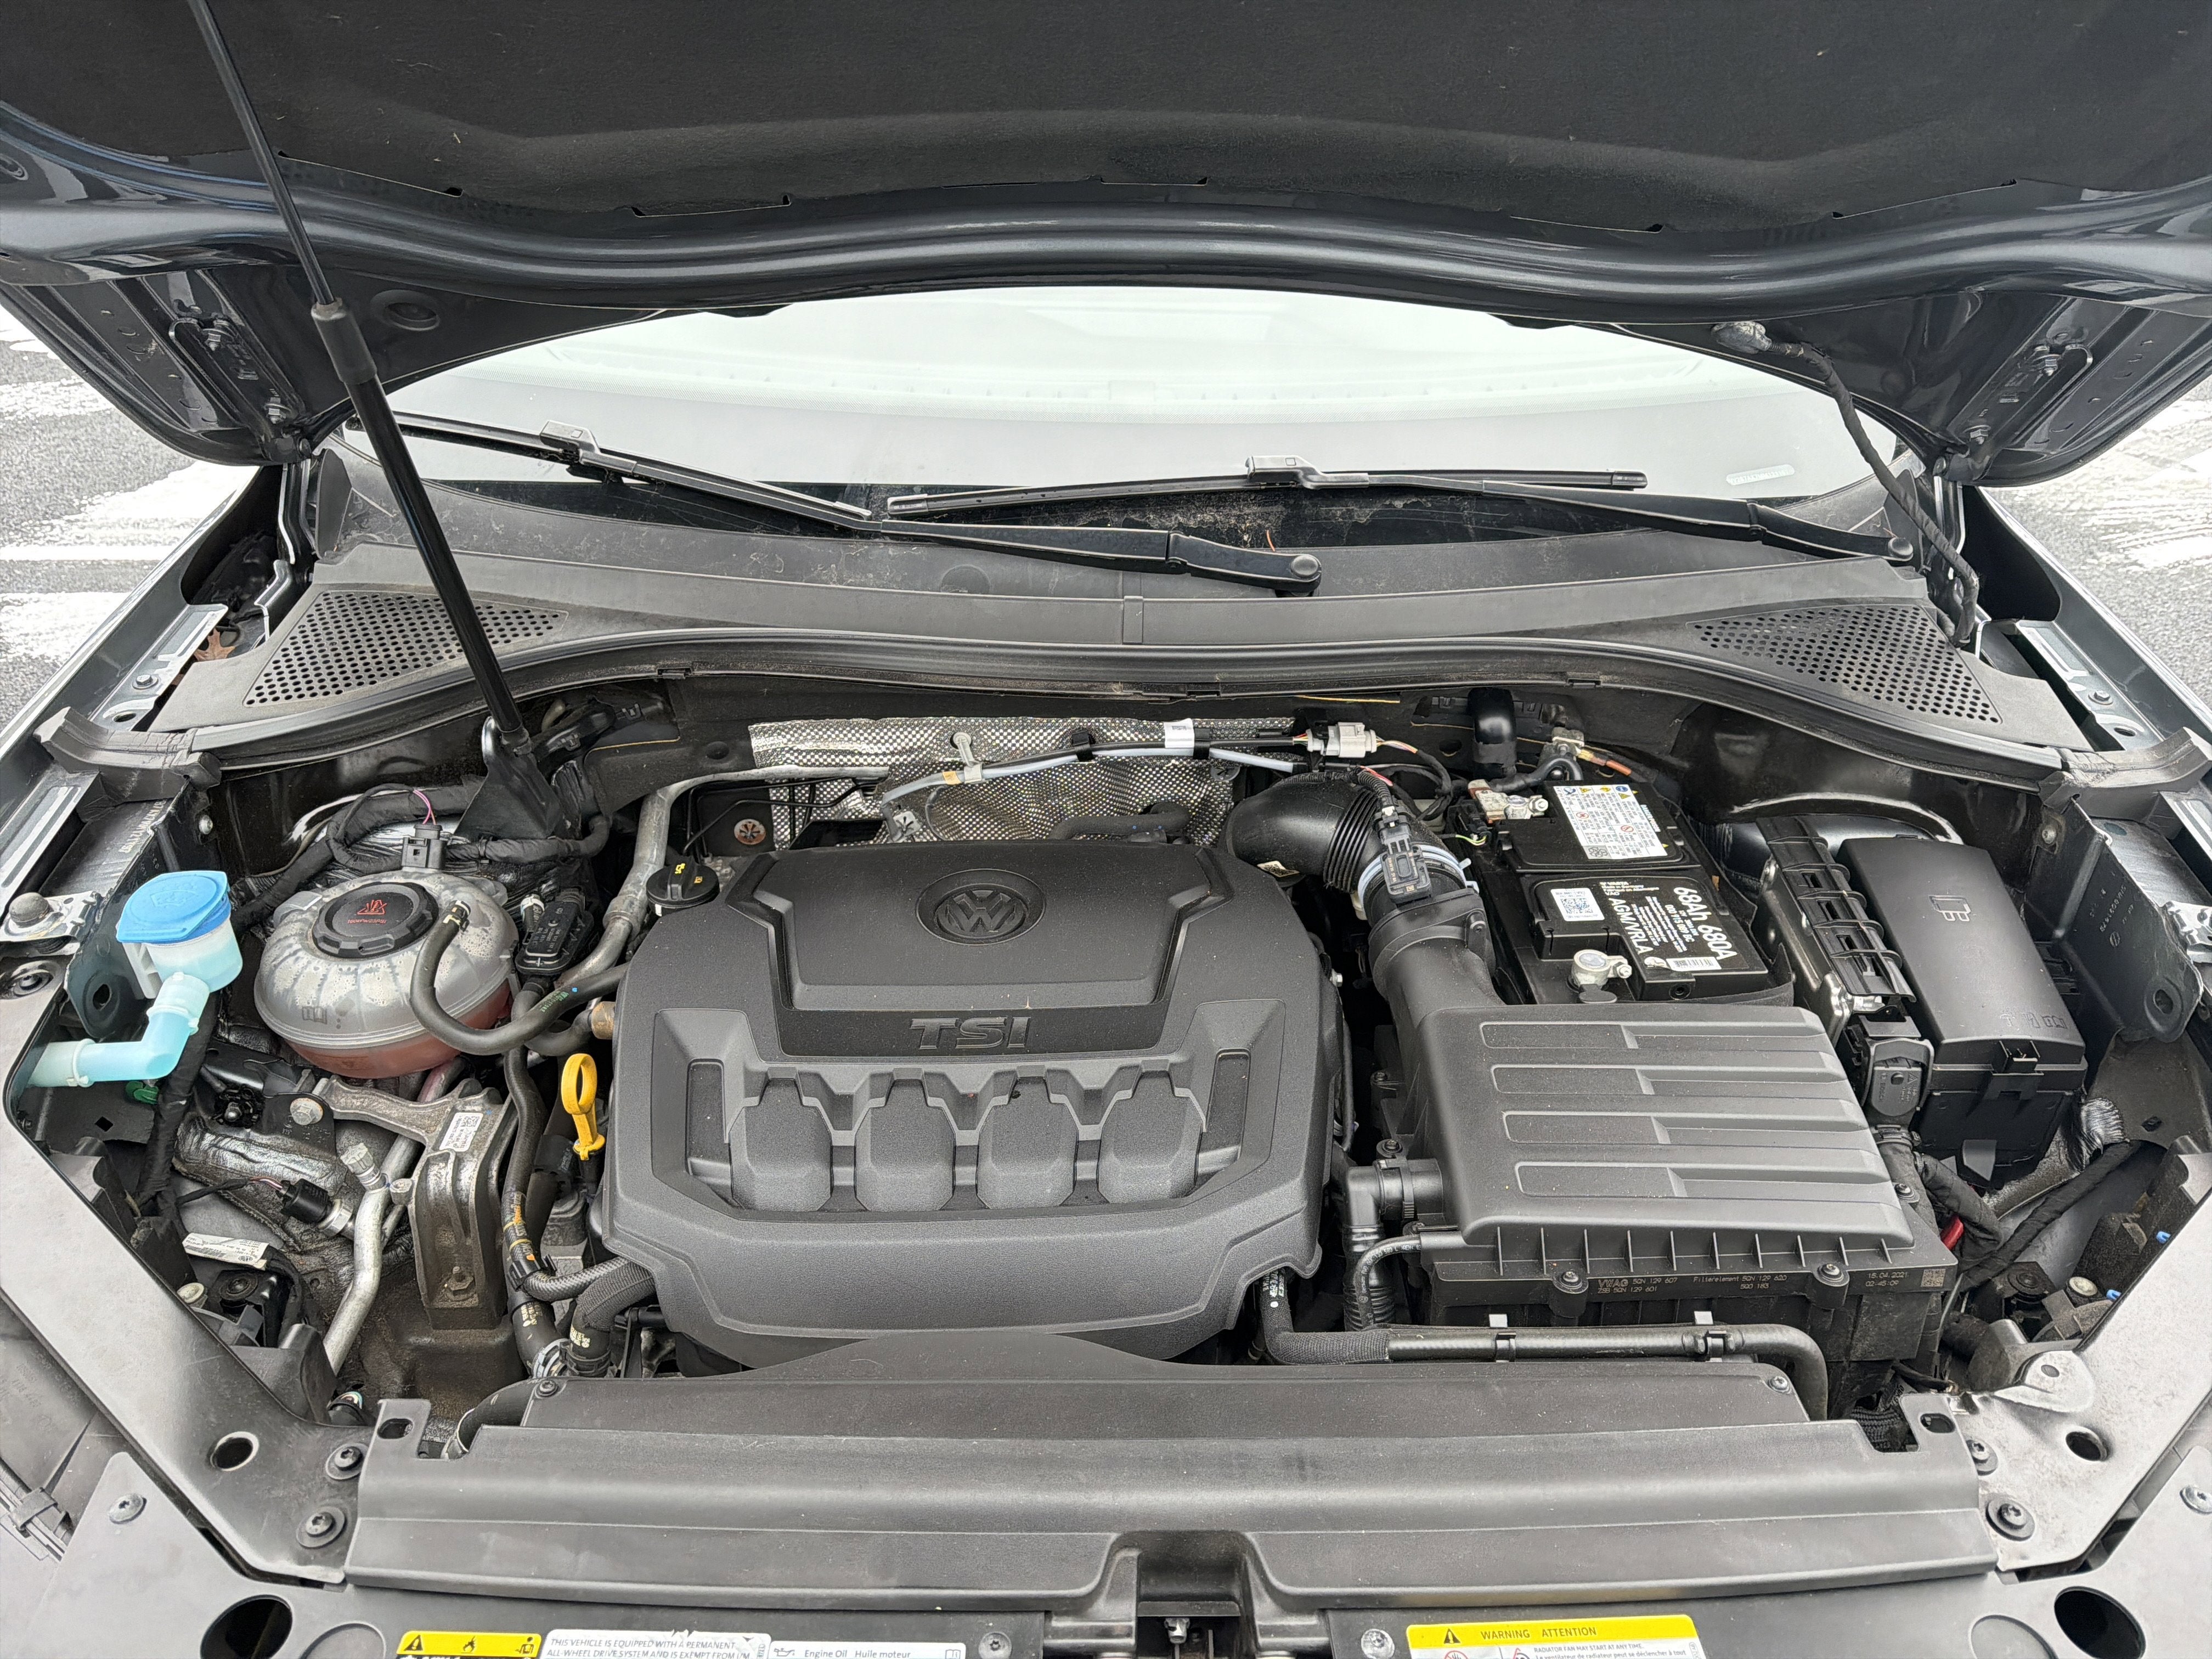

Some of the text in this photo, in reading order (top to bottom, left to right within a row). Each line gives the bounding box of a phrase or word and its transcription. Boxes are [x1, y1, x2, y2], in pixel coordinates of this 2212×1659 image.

[1608, 898, 1654, 955] AGM/VRLA
[1671, 914, 1684, 923] 915
[1683, 934, 1695, 942] BC
[1673, 887, 1737, 960] 68Ah 680A
[910, 1016, 1032, 1050] TSI
[1598, 1278, 1629, 1288] VWAG
[1480, 1627, 1597, 1640] WARNING ATTENTION
[570, 1639, 602, 1647] VEHICLE
[613, 1639, 653, 1649] EQUIPPED
[686, 1641, 736, 1649] PERMANENT
[546, 1649, 591, 1657] ALL-WHEEL
[804, 1649, 833, 1659] Engine
[835, 1650, 848, 1658] Oil
[855, 1650, 878, 1658] Huile
